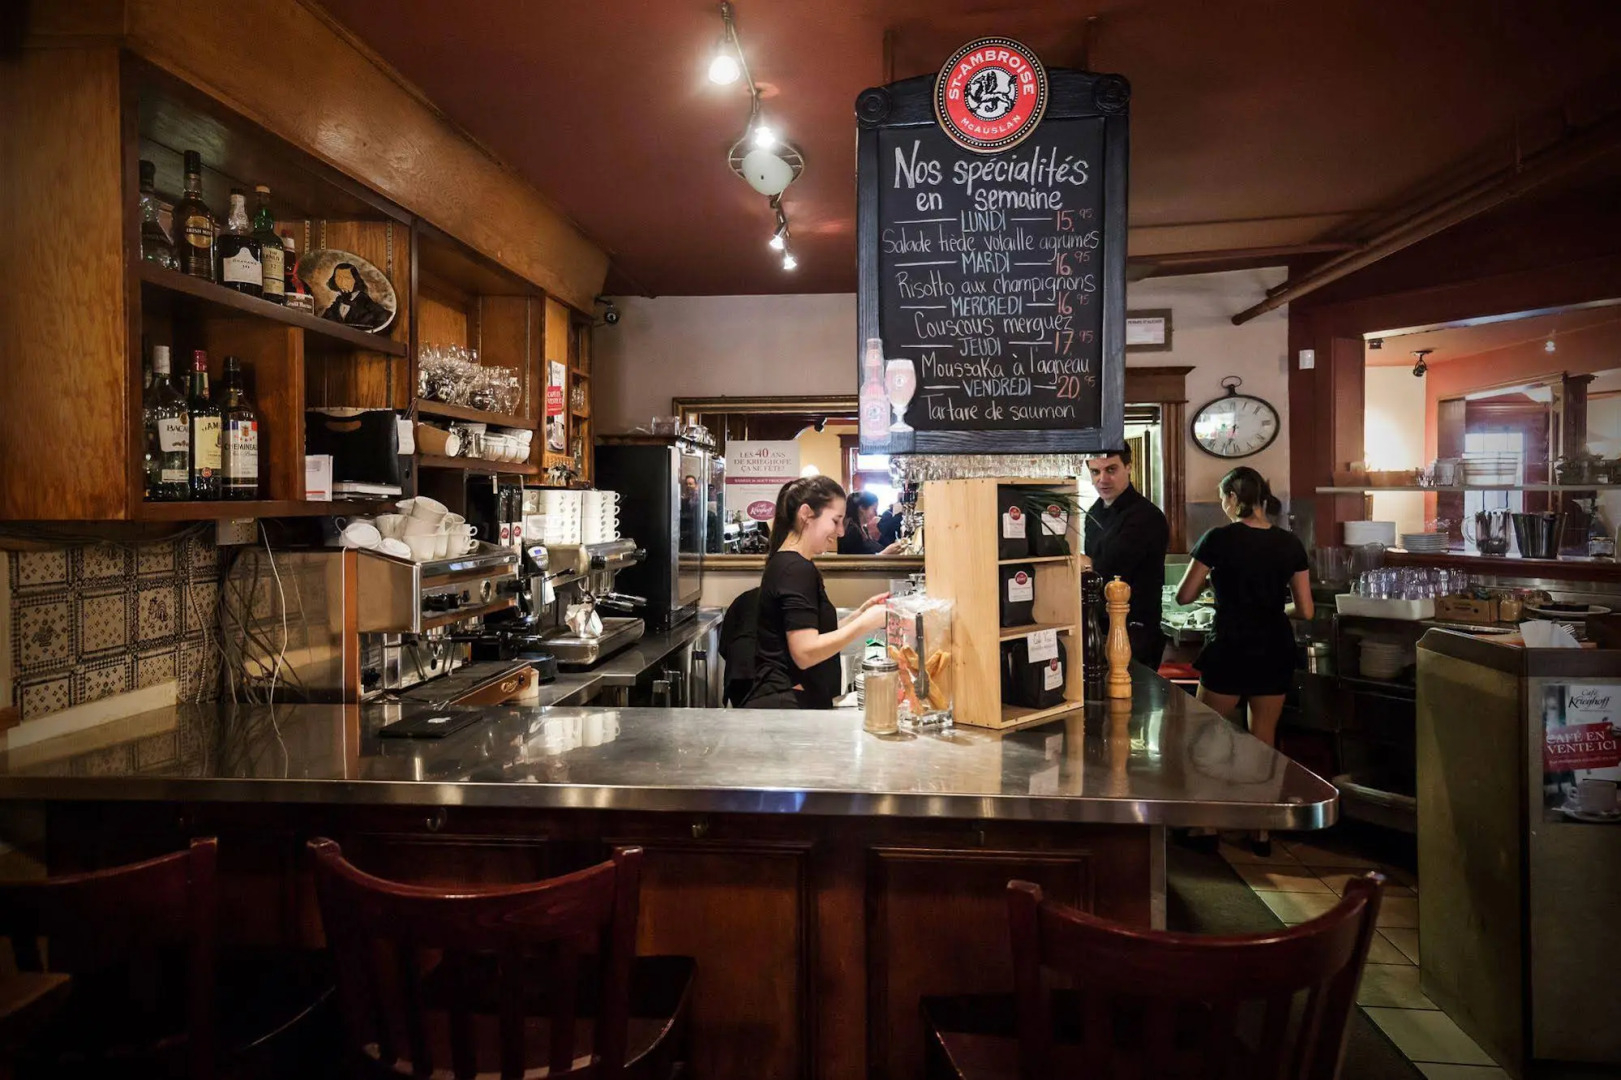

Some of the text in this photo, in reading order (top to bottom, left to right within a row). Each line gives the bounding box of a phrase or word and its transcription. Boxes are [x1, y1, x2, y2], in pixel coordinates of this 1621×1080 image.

[948, 49, 1035, 100] ST-AMBROISE
[893, 140, 1089, 196] Nos spécialités
[916, 188, 1063, 211] en semaine
[960, 210, 1007, 233] LUNDI
[882, 228, 932, 254] Salade
[984, 227, 1035, 253] volaille
[1039, 230, 1100, 263] agrumes
[961, 251, 1011, 275] MARDI
[895, 270, 1096, 301] Risotto aux champignons
[950, 296, 1022, 318] MERCREDI
[914, 311, 1073, 341] Couscous merguez
[959, 336, 1002, 357] JEUDI
[1012, 353, 1024, 374] à
[1029, 346, 1090, 384] l'agneau
[962, 378, 1032, 398] VENDREDI
[920, 393, 1075, 421] Tartare de saumon
[755, 448, 769, 458] 40
[1568, 697, 1610, 709] Krieghoff
[1581, 688, 1599, 698] Café
[1546, 730, 1606, 744] CAFÉ EN
[1547, 741, 1617, 754] VENTE ICI
